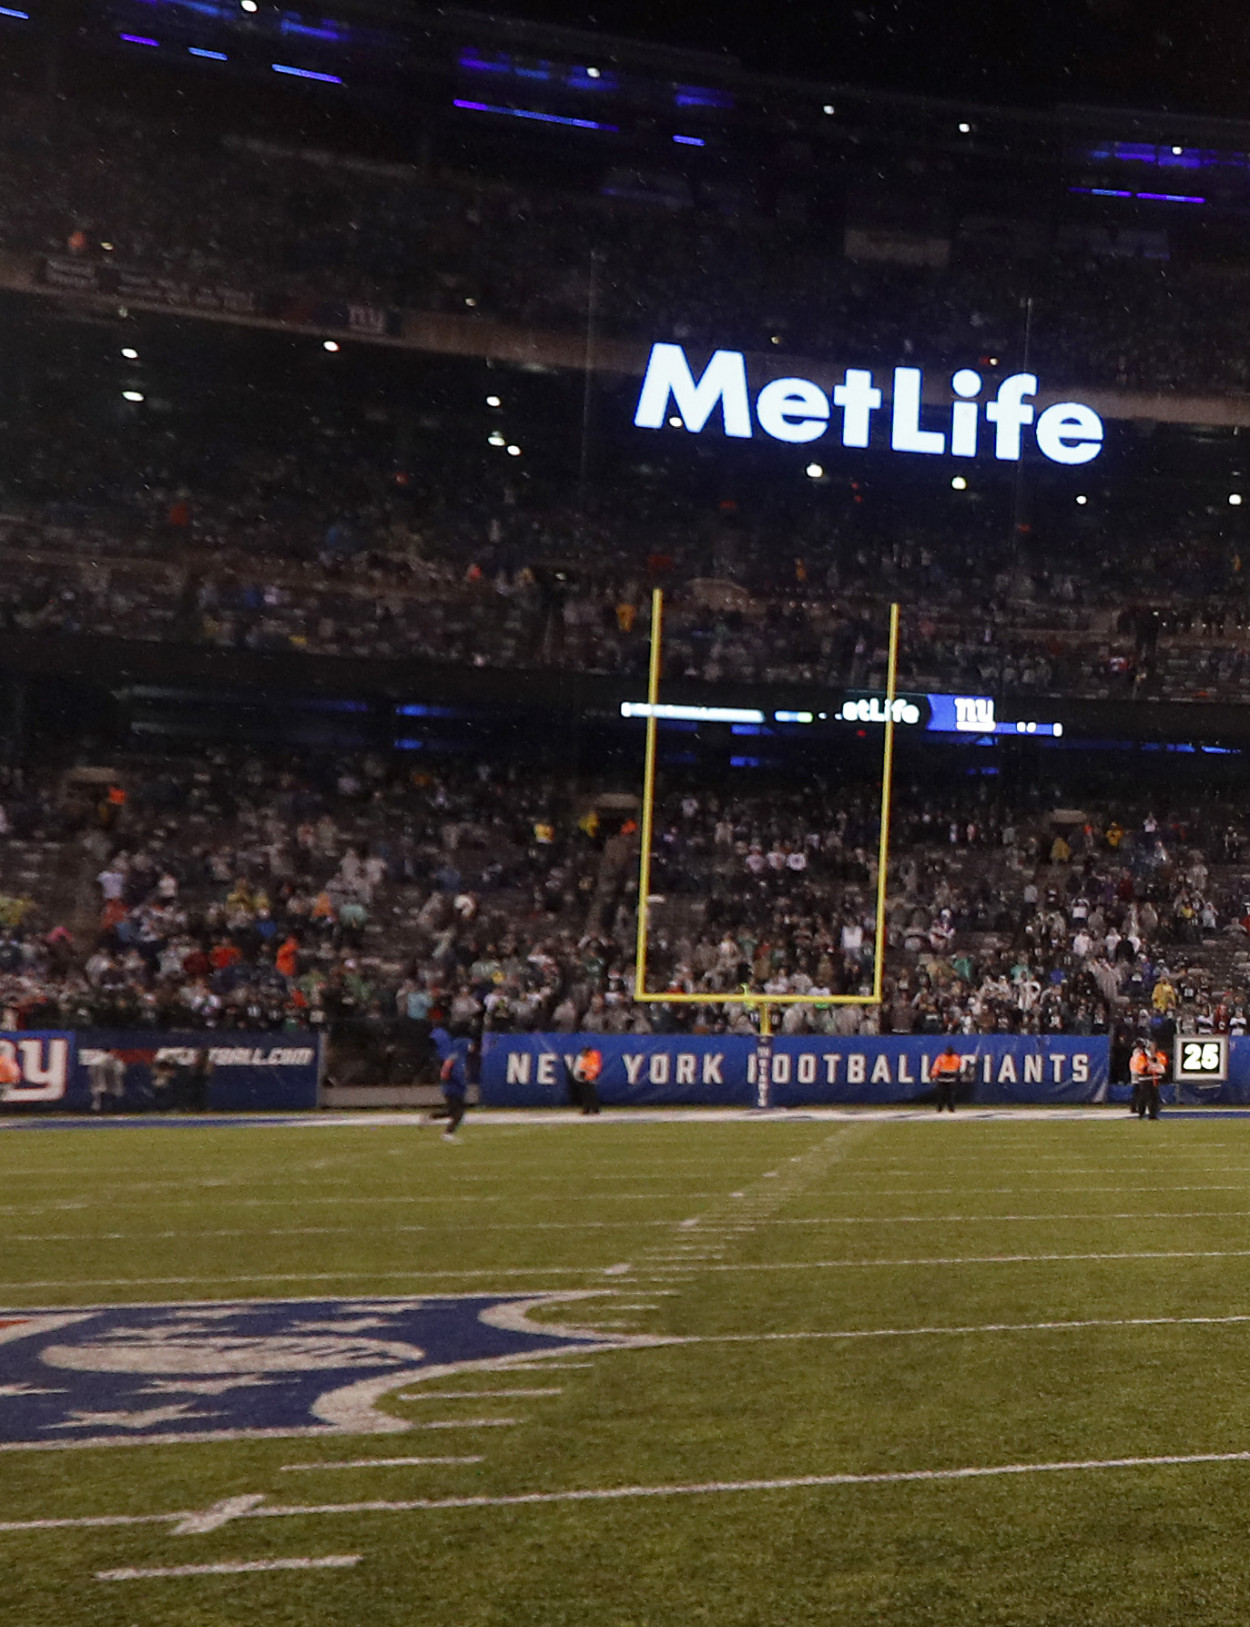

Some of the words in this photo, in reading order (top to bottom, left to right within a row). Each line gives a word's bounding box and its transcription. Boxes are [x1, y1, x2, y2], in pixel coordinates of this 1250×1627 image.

[634, 342, 1104, 465] MetLife
[622, 1053, 725, 1085] YORK
[1183, 1043, 1219, 1070] 25
